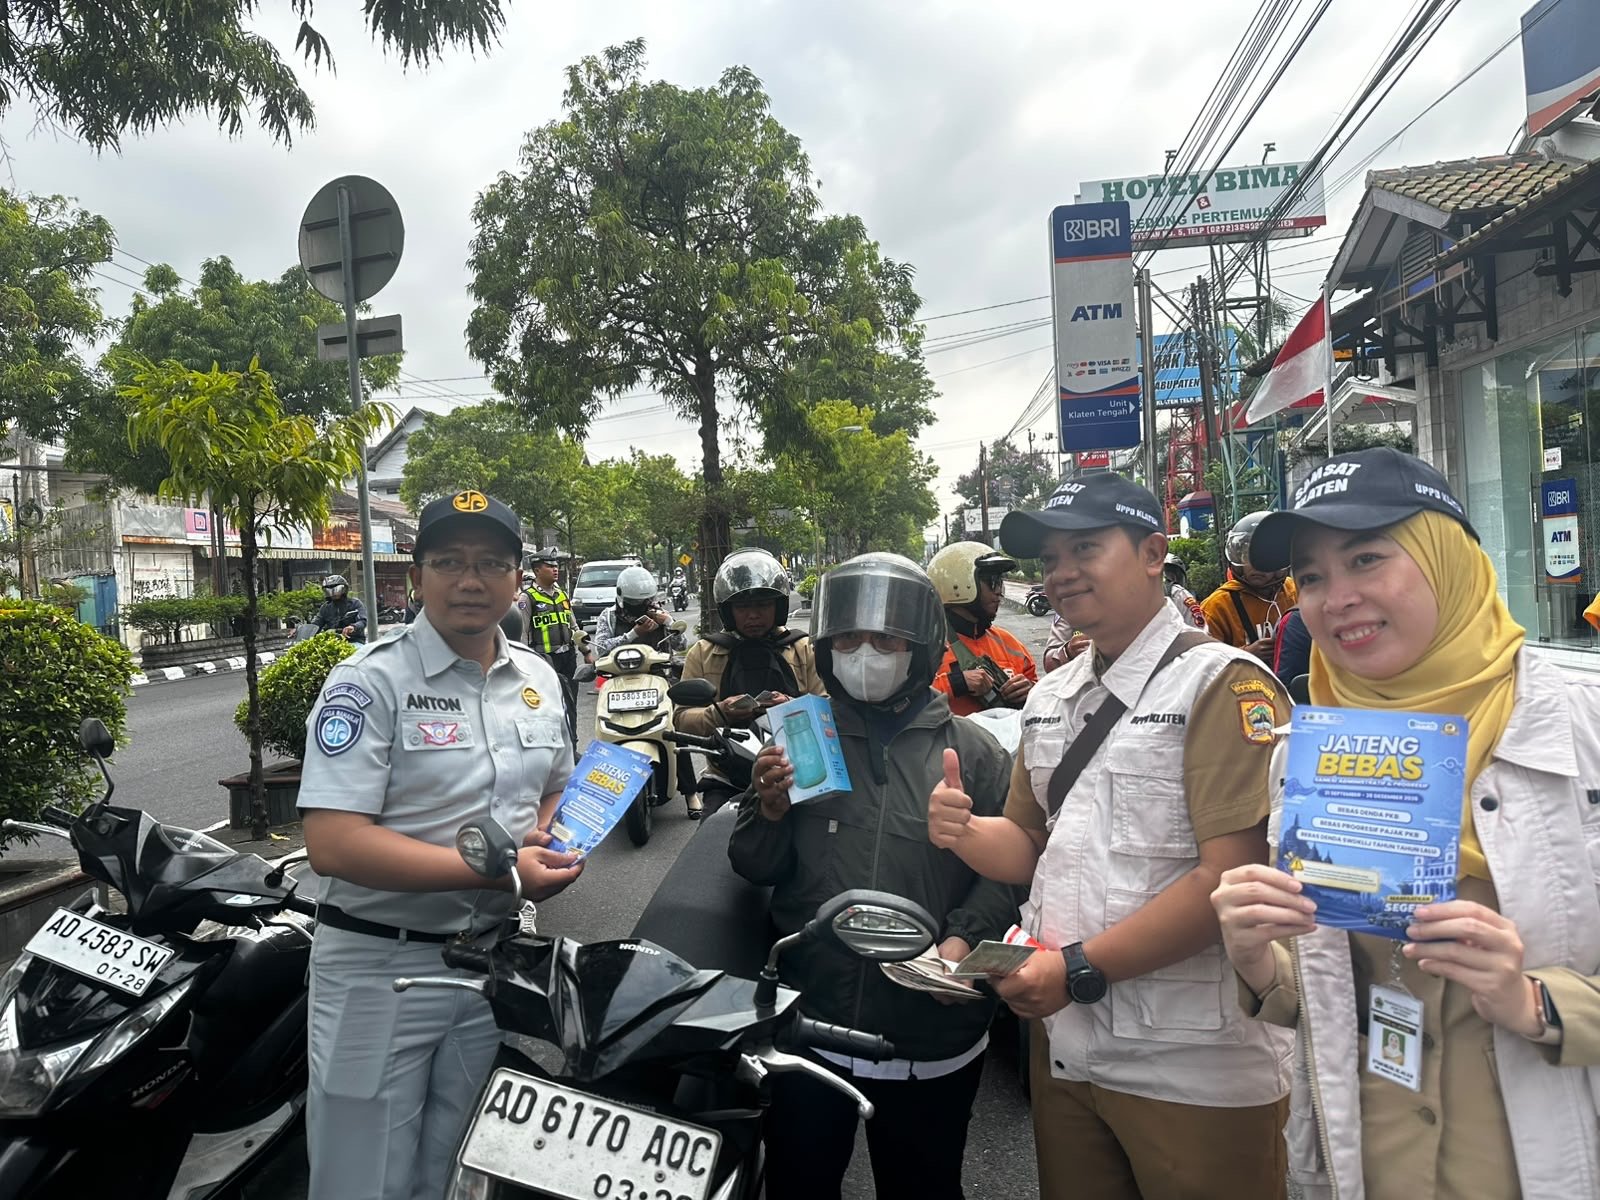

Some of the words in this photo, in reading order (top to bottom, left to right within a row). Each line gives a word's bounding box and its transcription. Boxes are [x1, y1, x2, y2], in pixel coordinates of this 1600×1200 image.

[1101, 174, 1208, 202] HOTEL
[1215, 165, 1299, 193] BIMA
[1199, 198, 1208, 208] &
[1086, 218, 1120, 239] BRI
[1130, 215, 1187, 230] GEDUNG
[1188, 227, 1204, 235] TELP
[1070, 303, 1122, 322] ATM
[1154, 377, 1200, 391] ABUPATEN
[1109, 400, 1127, 408] Unit
[1068, 410, 1095, 419] Klaten
[1098, 408, 1128, 418] Tengah
[1556, 490, 1570, 505] BRI
[1551, 530, 1571, 543] ATM
[406, 693, 462, 711] ANTON
[1149, 713, 1186, 726] KLATEN
[1319, 734, 1420, 756] JATENG
[594, 760, 631, 783] JATENG
[1316, 752, 1425, 781] BEBAS
[586, 769, 627, 796] BEBAS
[1337, 806, 1359, 815] BEBAS
[1359, 809, 1383, 818] DENDA
[1385, 812, 1400, 820] PKB
[1320, 819, 1341, 828] BEBAS
[1341, 822, 1378, 833] PROGRESIF
[1379, 827, 1404, 837] PAJAK
[1405, 830, 1420, 838] PKB
[1301, 831, 1320, 840] BEBAS
[1320, 834, 1341, 842] DENDA
[1383, 902, 1422, 914] SEGE
[46, 914, 80, 940] AD
[77, 925, 134, 961] 4583
[132, 945, 168, 974] SW
[619, 943, 661, 956] HONDA
[131, 1060, 187, 1098] HONDA
[484, 1079, 539, 1125] AD
[541, 1095, 631, 1153] 6170
